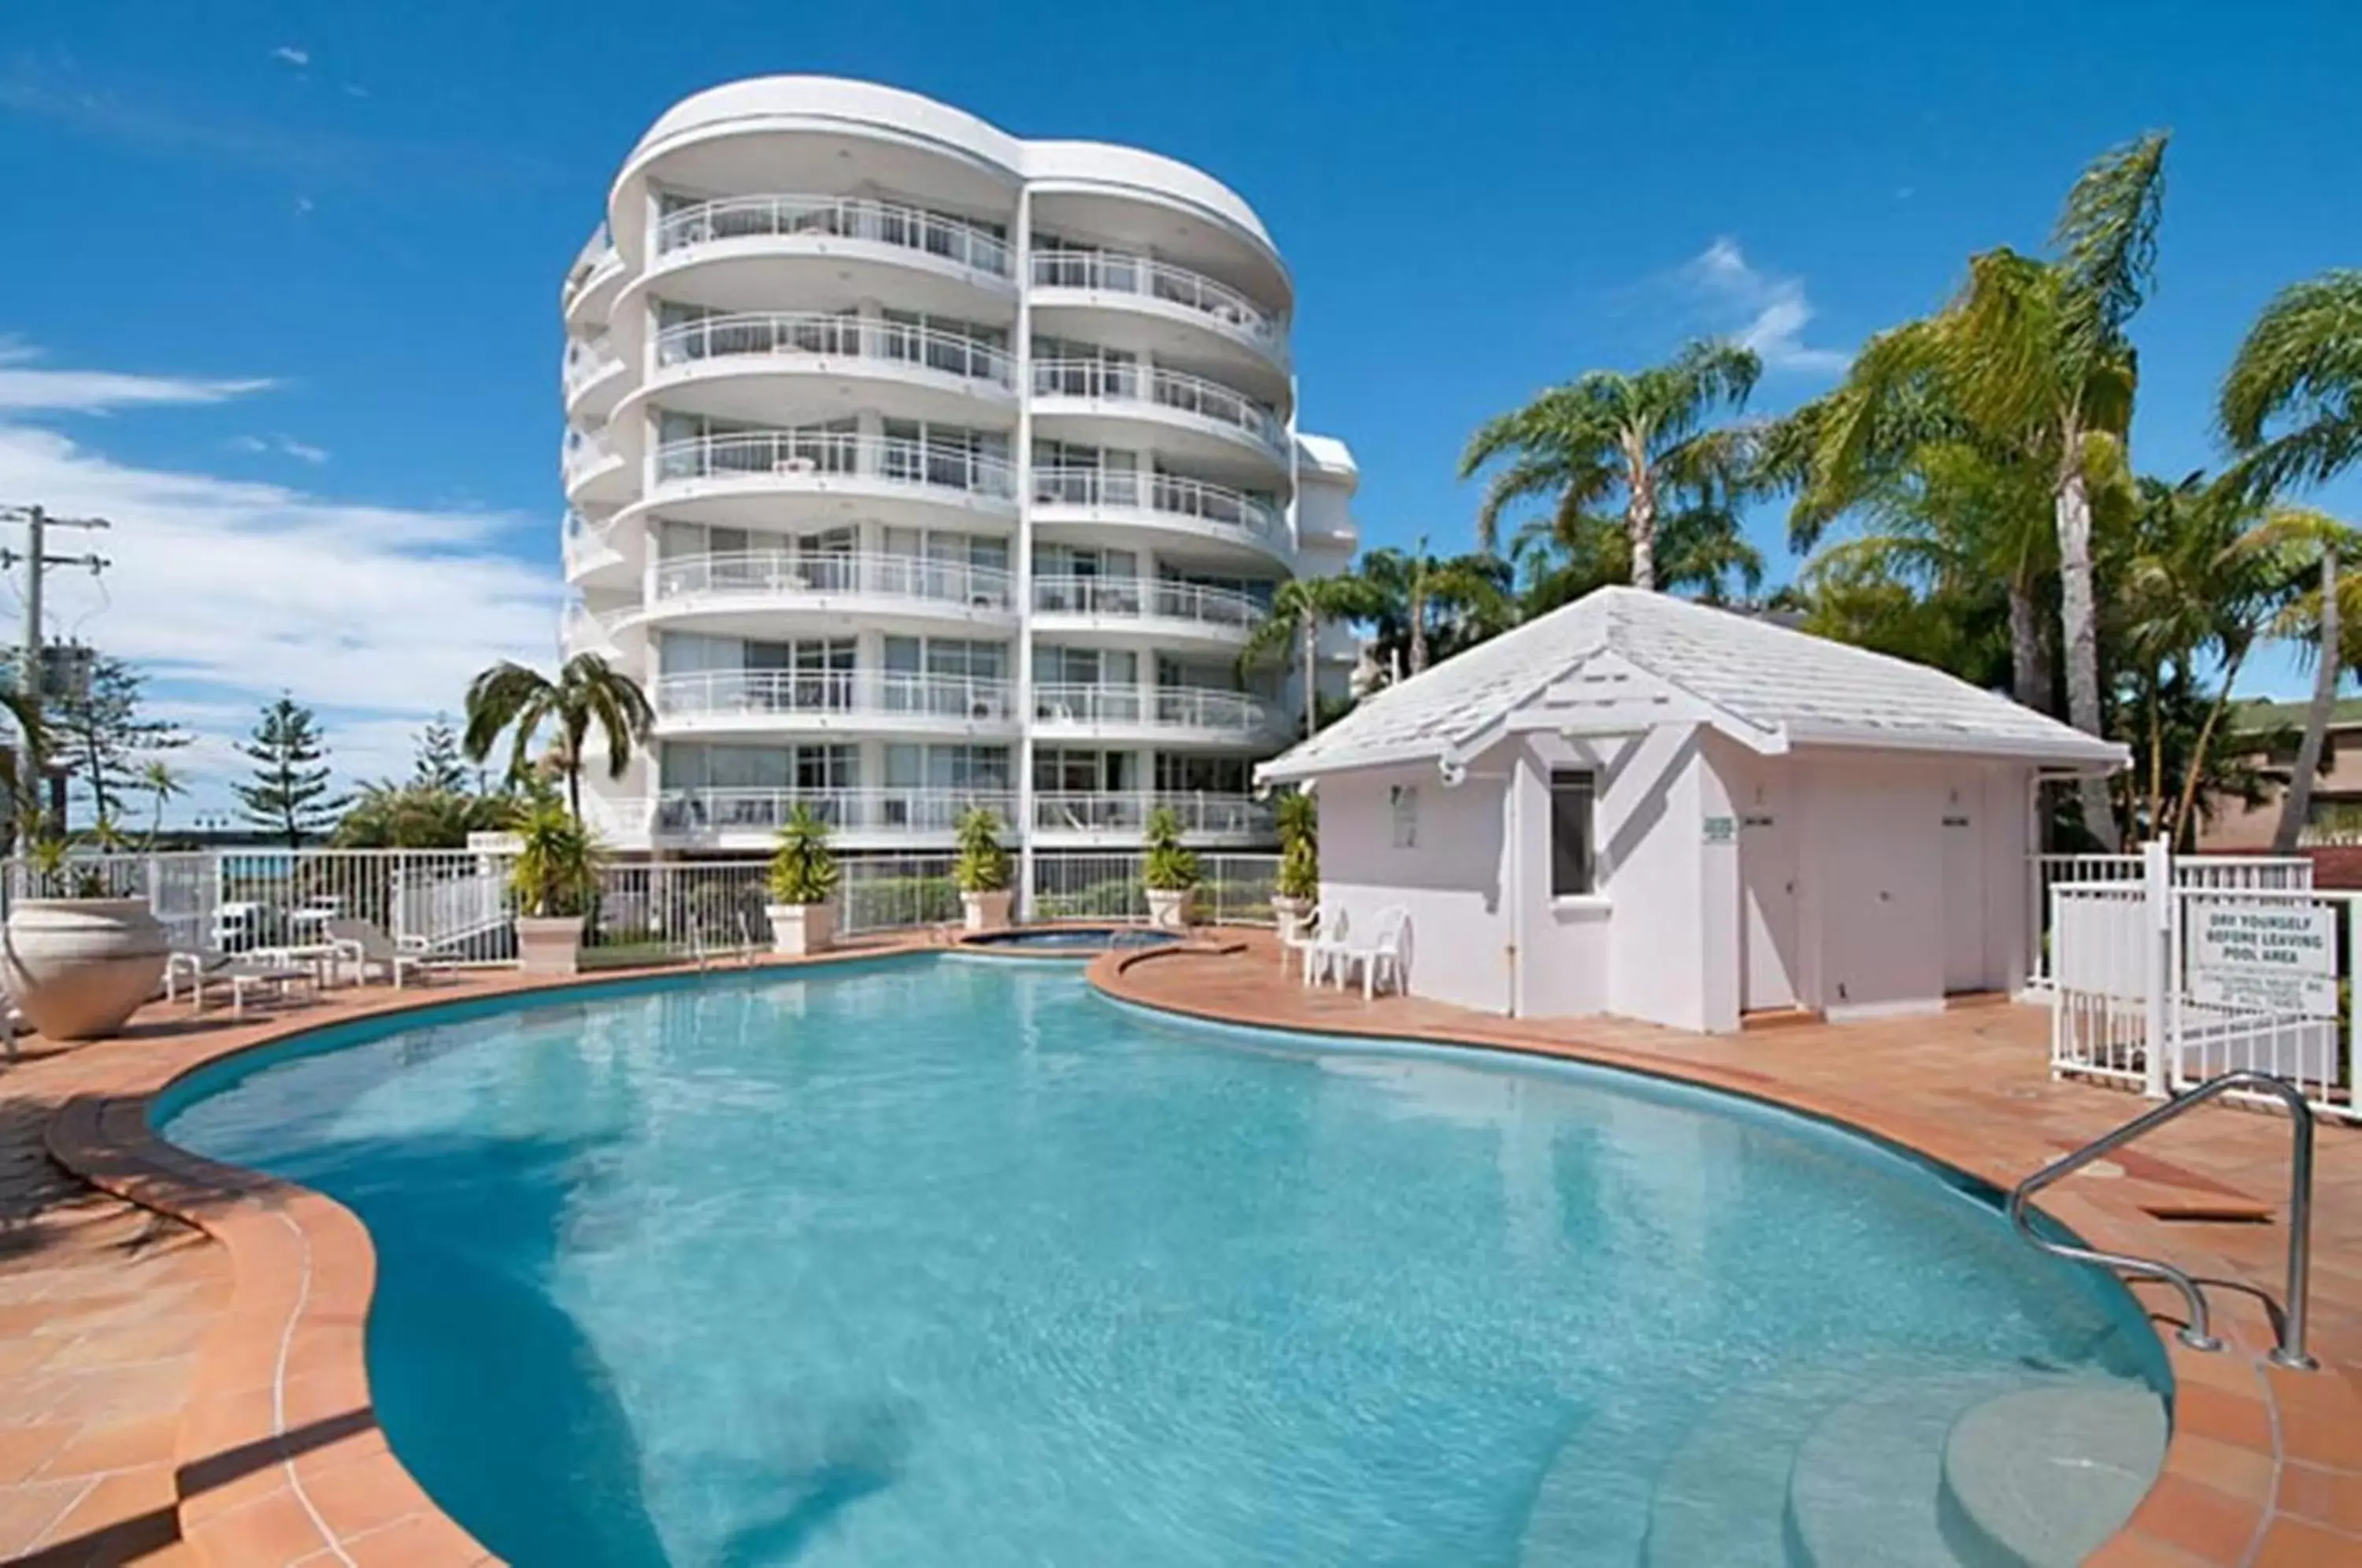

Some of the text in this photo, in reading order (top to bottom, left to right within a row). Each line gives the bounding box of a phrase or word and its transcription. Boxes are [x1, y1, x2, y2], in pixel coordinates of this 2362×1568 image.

[2241, 915, 2312, 930] YOURSELF
[2207, 931, 2323, 949] BEFORE LEAVING
[2223, 948, 2297, 963] POOL AREA
